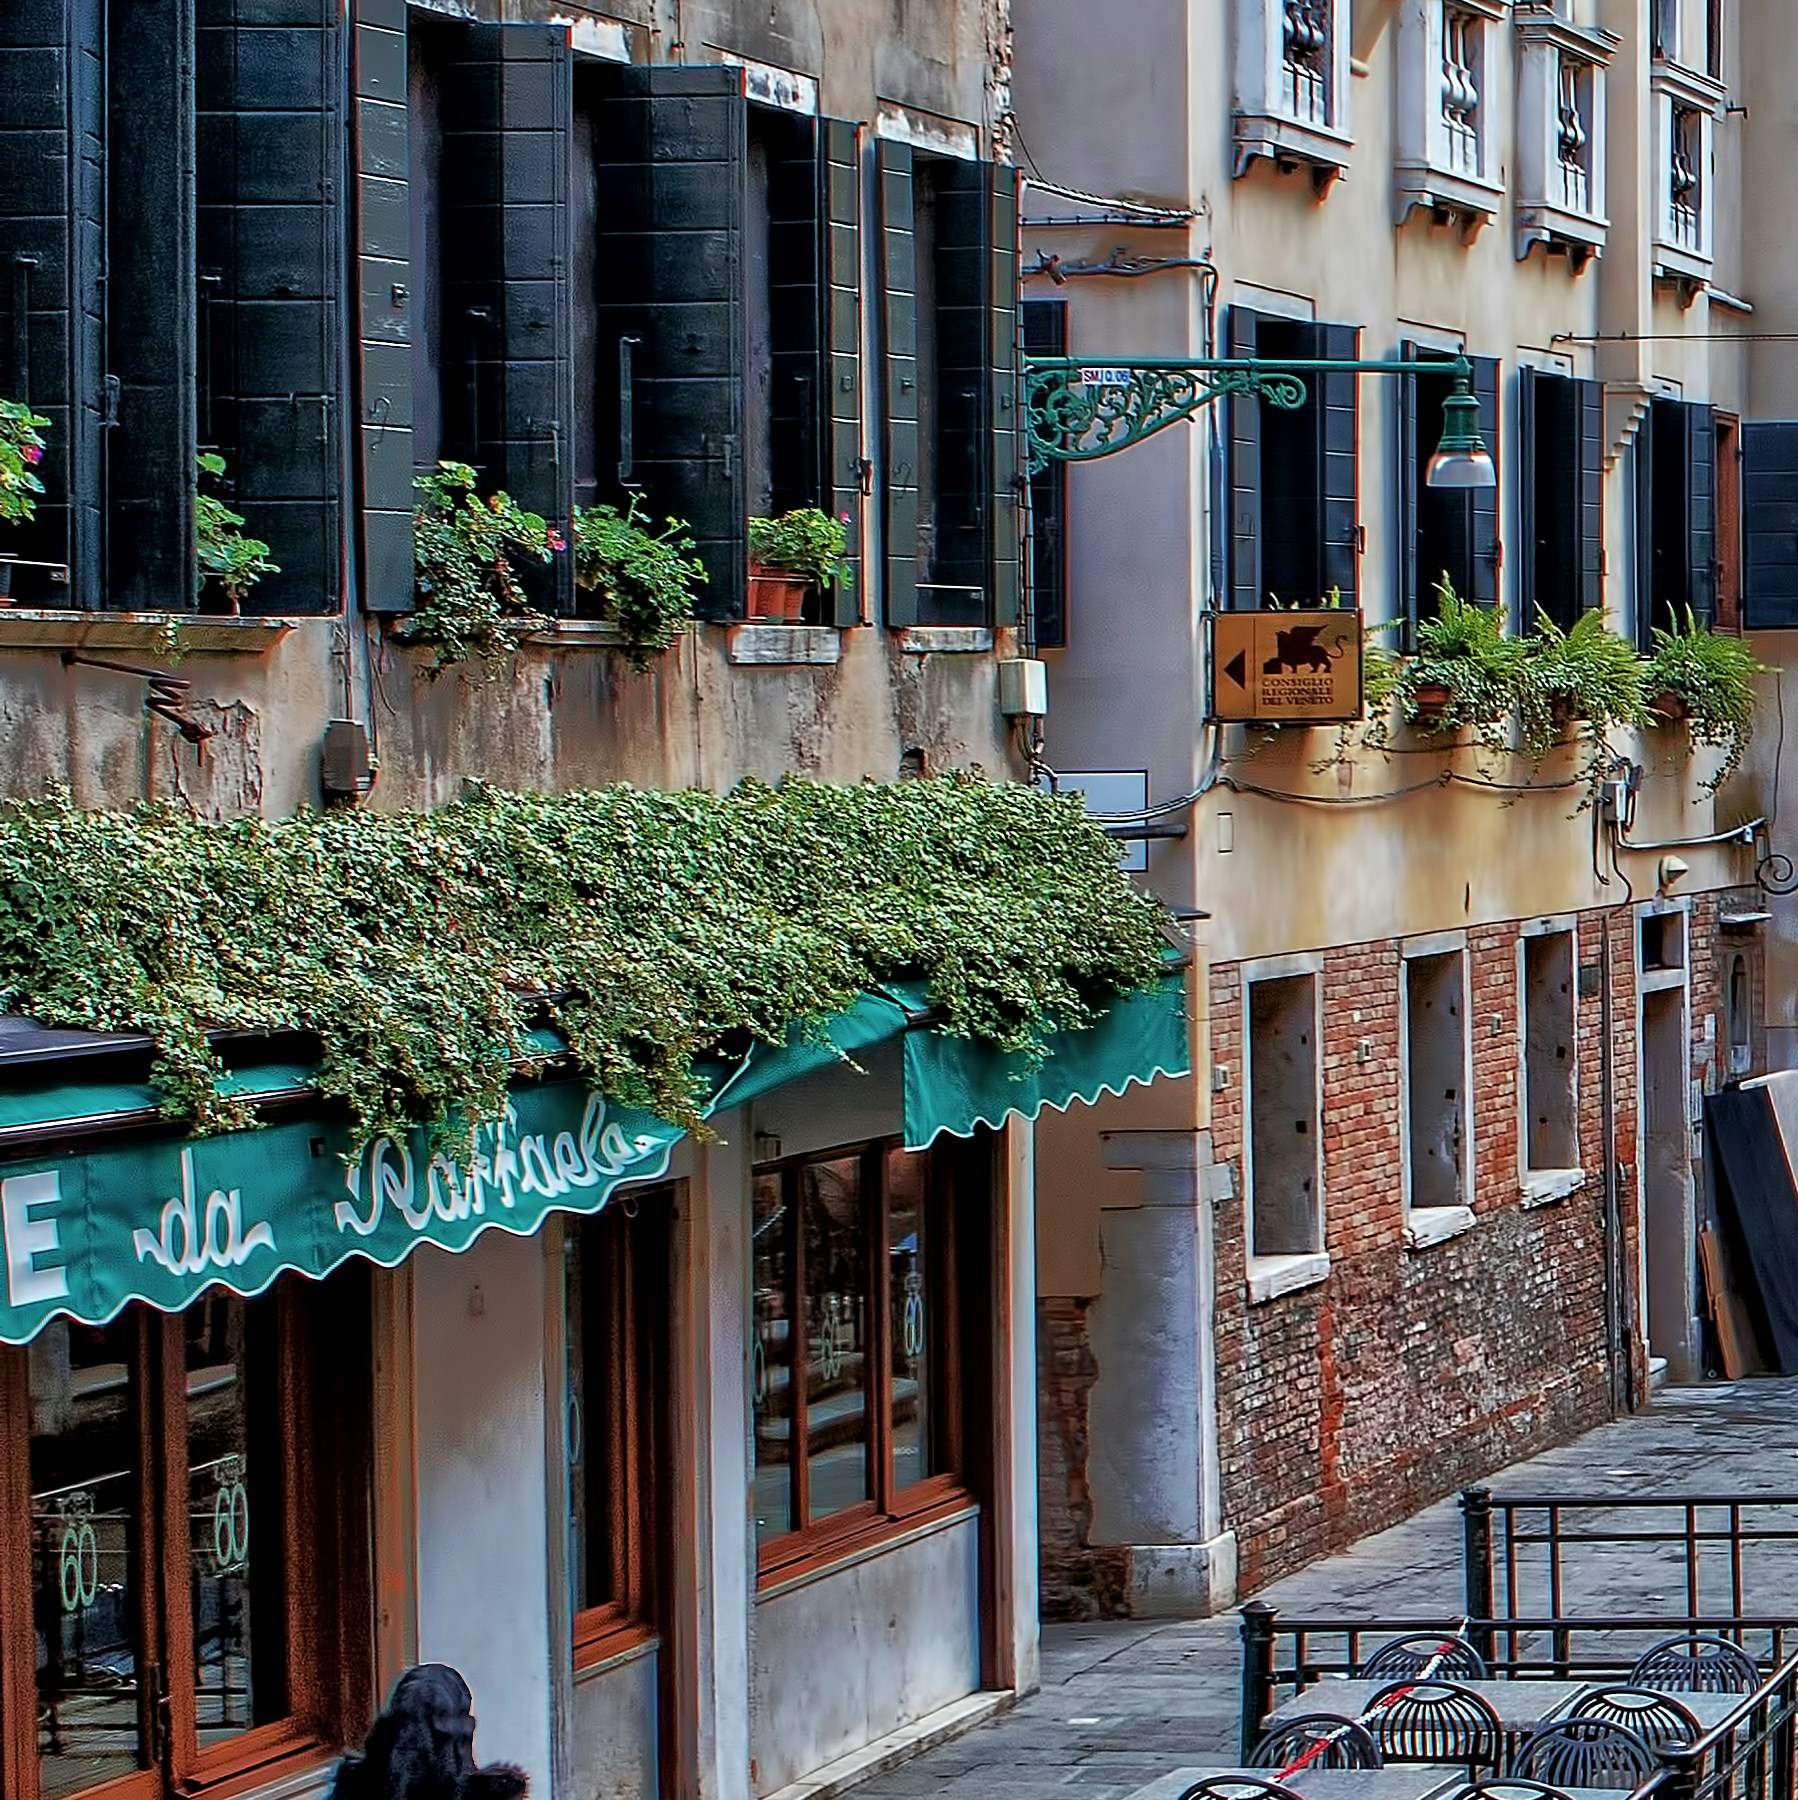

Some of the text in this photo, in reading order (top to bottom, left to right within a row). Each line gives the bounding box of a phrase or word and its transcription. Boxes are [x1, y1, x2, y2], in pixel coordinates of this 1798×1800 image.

[1262, 677, 1333, 687] CONSIGLIO
[1262, 687, 1333, 696] REGIONALE
[1262, 696, 1334, 705] DEL VENETO
[134, 1148, 277, 1276] da
[334, 1091, 671, 1237] Raffaele
[215, 1482, 249, 1566] 60
[61, 1524, 97, 1611] 60
